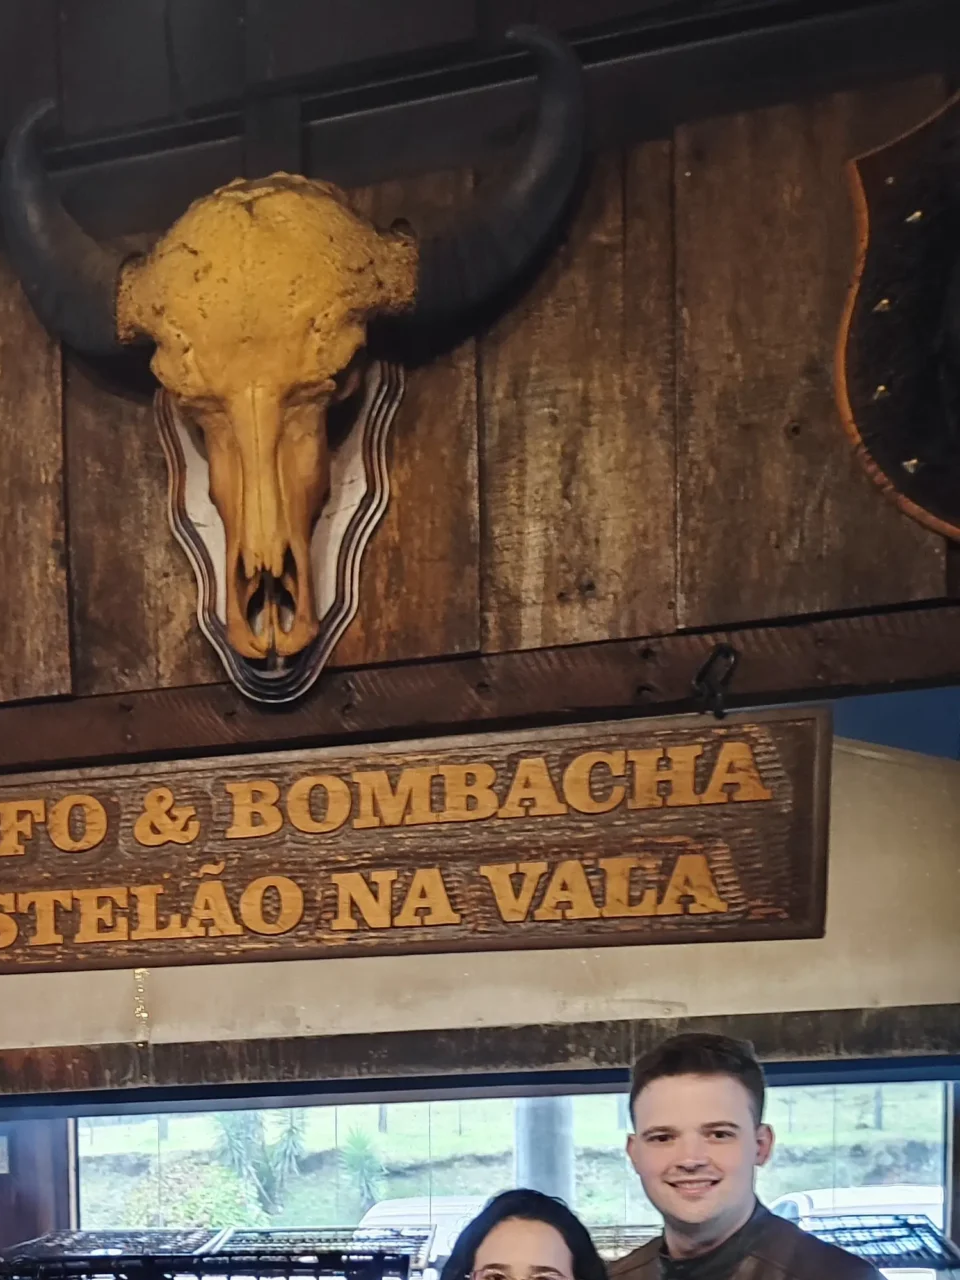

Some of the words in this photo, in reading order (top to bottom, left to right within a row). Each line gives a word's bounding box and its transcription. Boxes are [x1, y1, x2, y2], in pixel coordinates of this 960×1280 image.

[133, 786, 201, 847] &
[225, 741, 773, 839] BOMBACHA
[330, 867, 462, 931] NA
[480, 854, 728, 922] VALA
